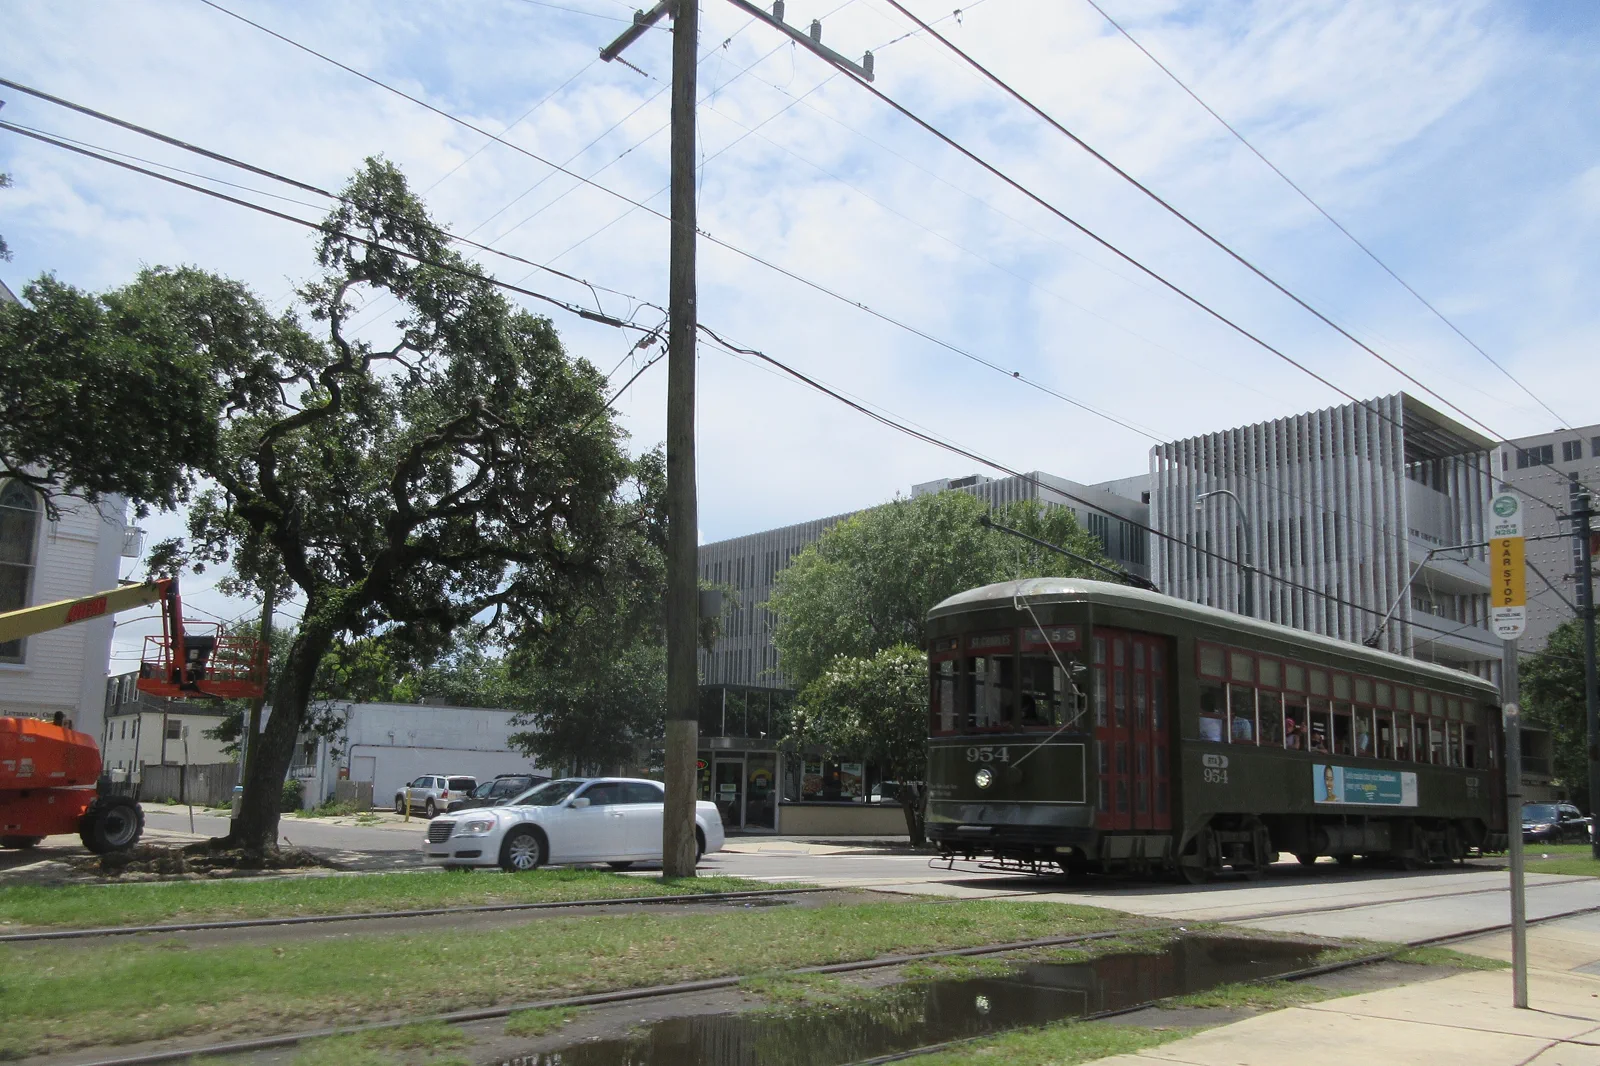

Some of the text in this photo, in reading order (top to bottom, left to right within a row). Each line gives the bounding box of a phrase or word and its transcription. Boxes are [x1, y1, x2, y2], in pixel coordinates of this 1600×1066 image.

[1502, 540, 1513, 605] CAR STOP
[966, 747, 1010, 762] 954
[1203, 768, 1228, 783] 954
